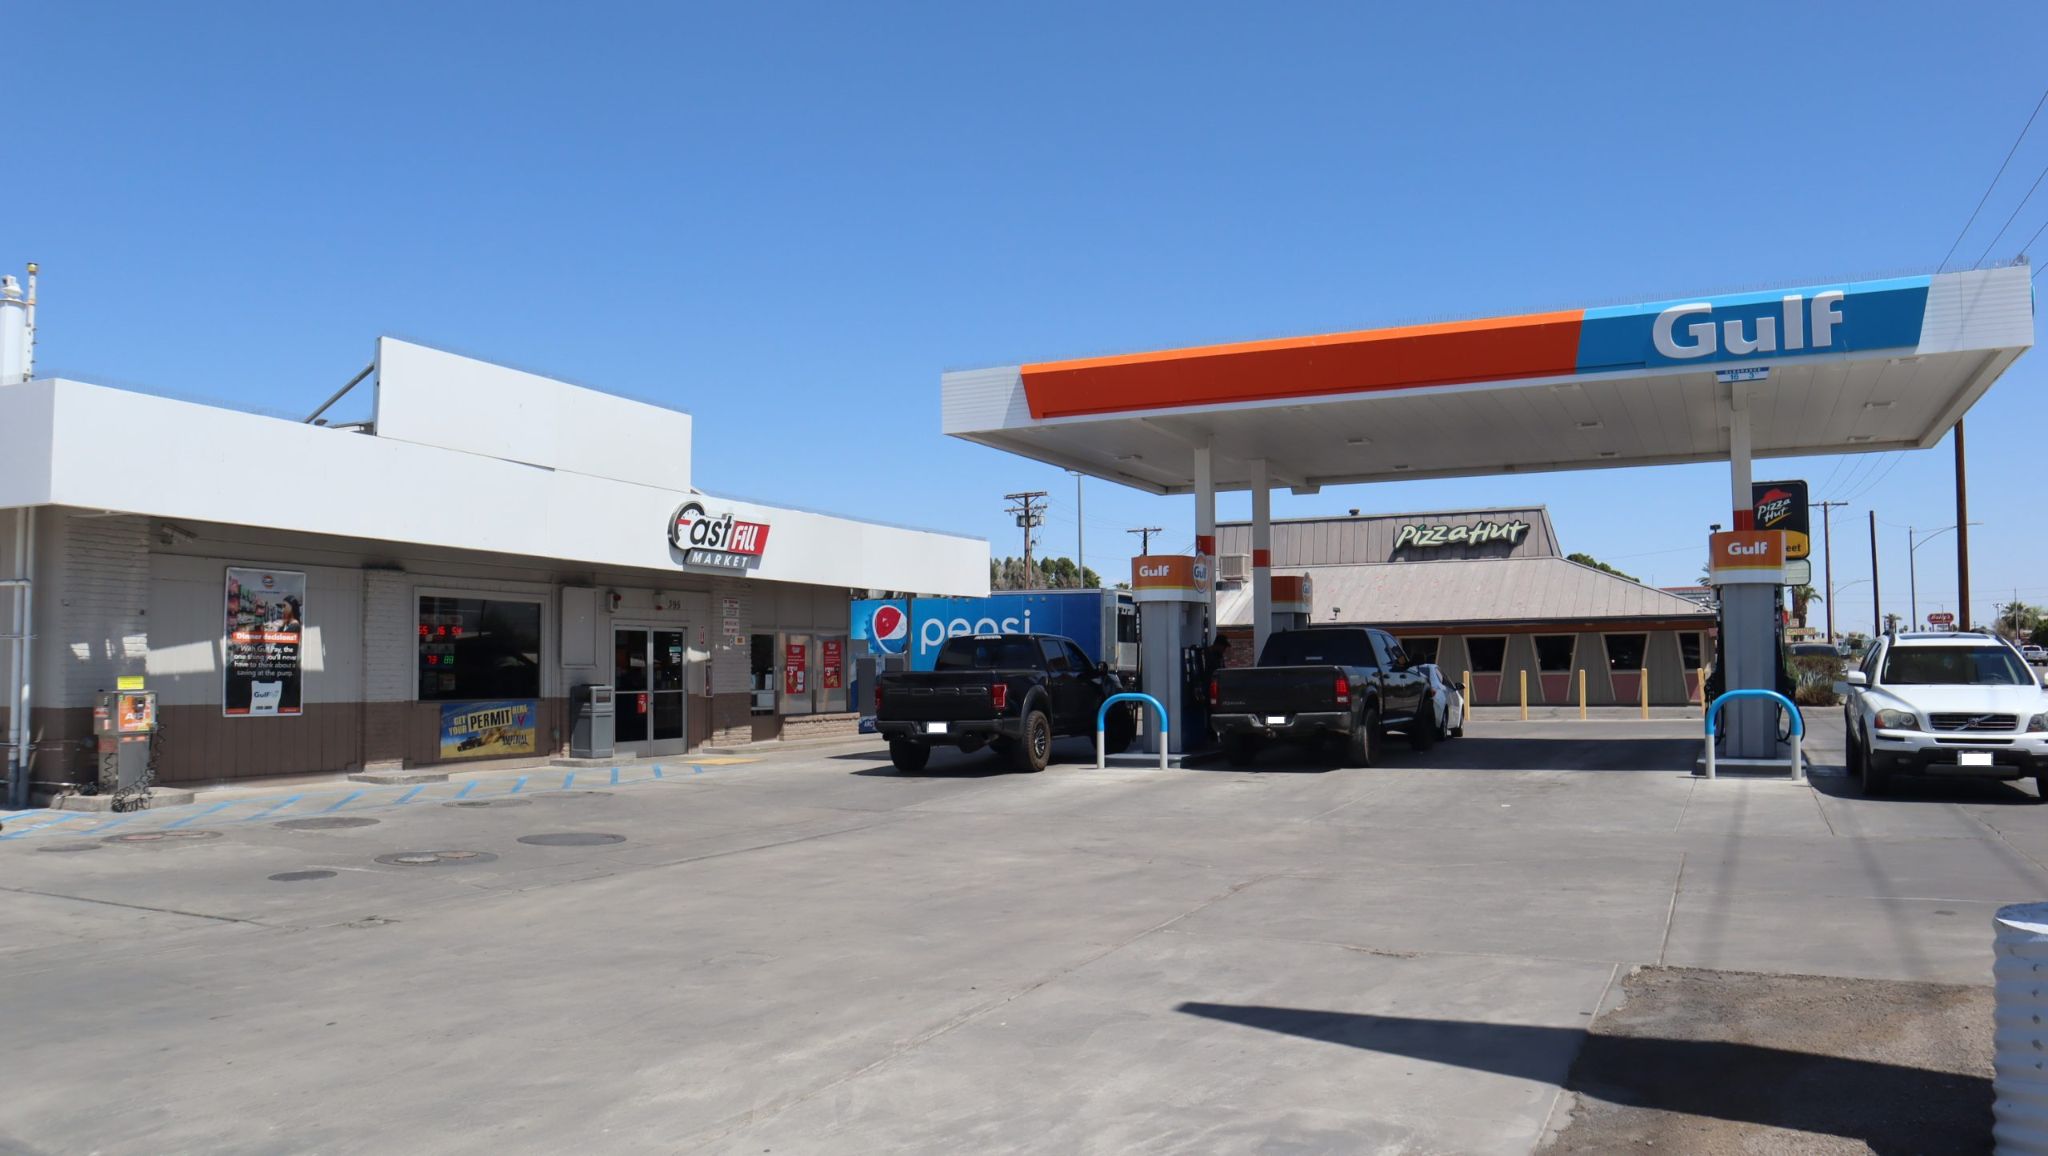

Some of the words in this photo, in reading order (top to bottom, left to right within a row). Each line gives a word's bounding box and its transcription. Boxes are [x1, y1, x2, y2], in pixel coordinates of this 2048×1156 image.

[1652, 290, 1844, 359] Gulf
[1757, 498, 1791, 520] Pizza
[1764, 507, 1789, 522] Hut
[674, 502, 732, 547] Fast
[731, 525, 759, 551] Fill
[1728, 541, 1768, 556] Gulf
[692, 552, 748, 567] MARKET
[1139, 564, 1169, 577] Gulf
[236, 632, 261, 640] Dinner
[470, 710, 511, 729] PERMIT
[448, 725, 467, 736] YOUR
